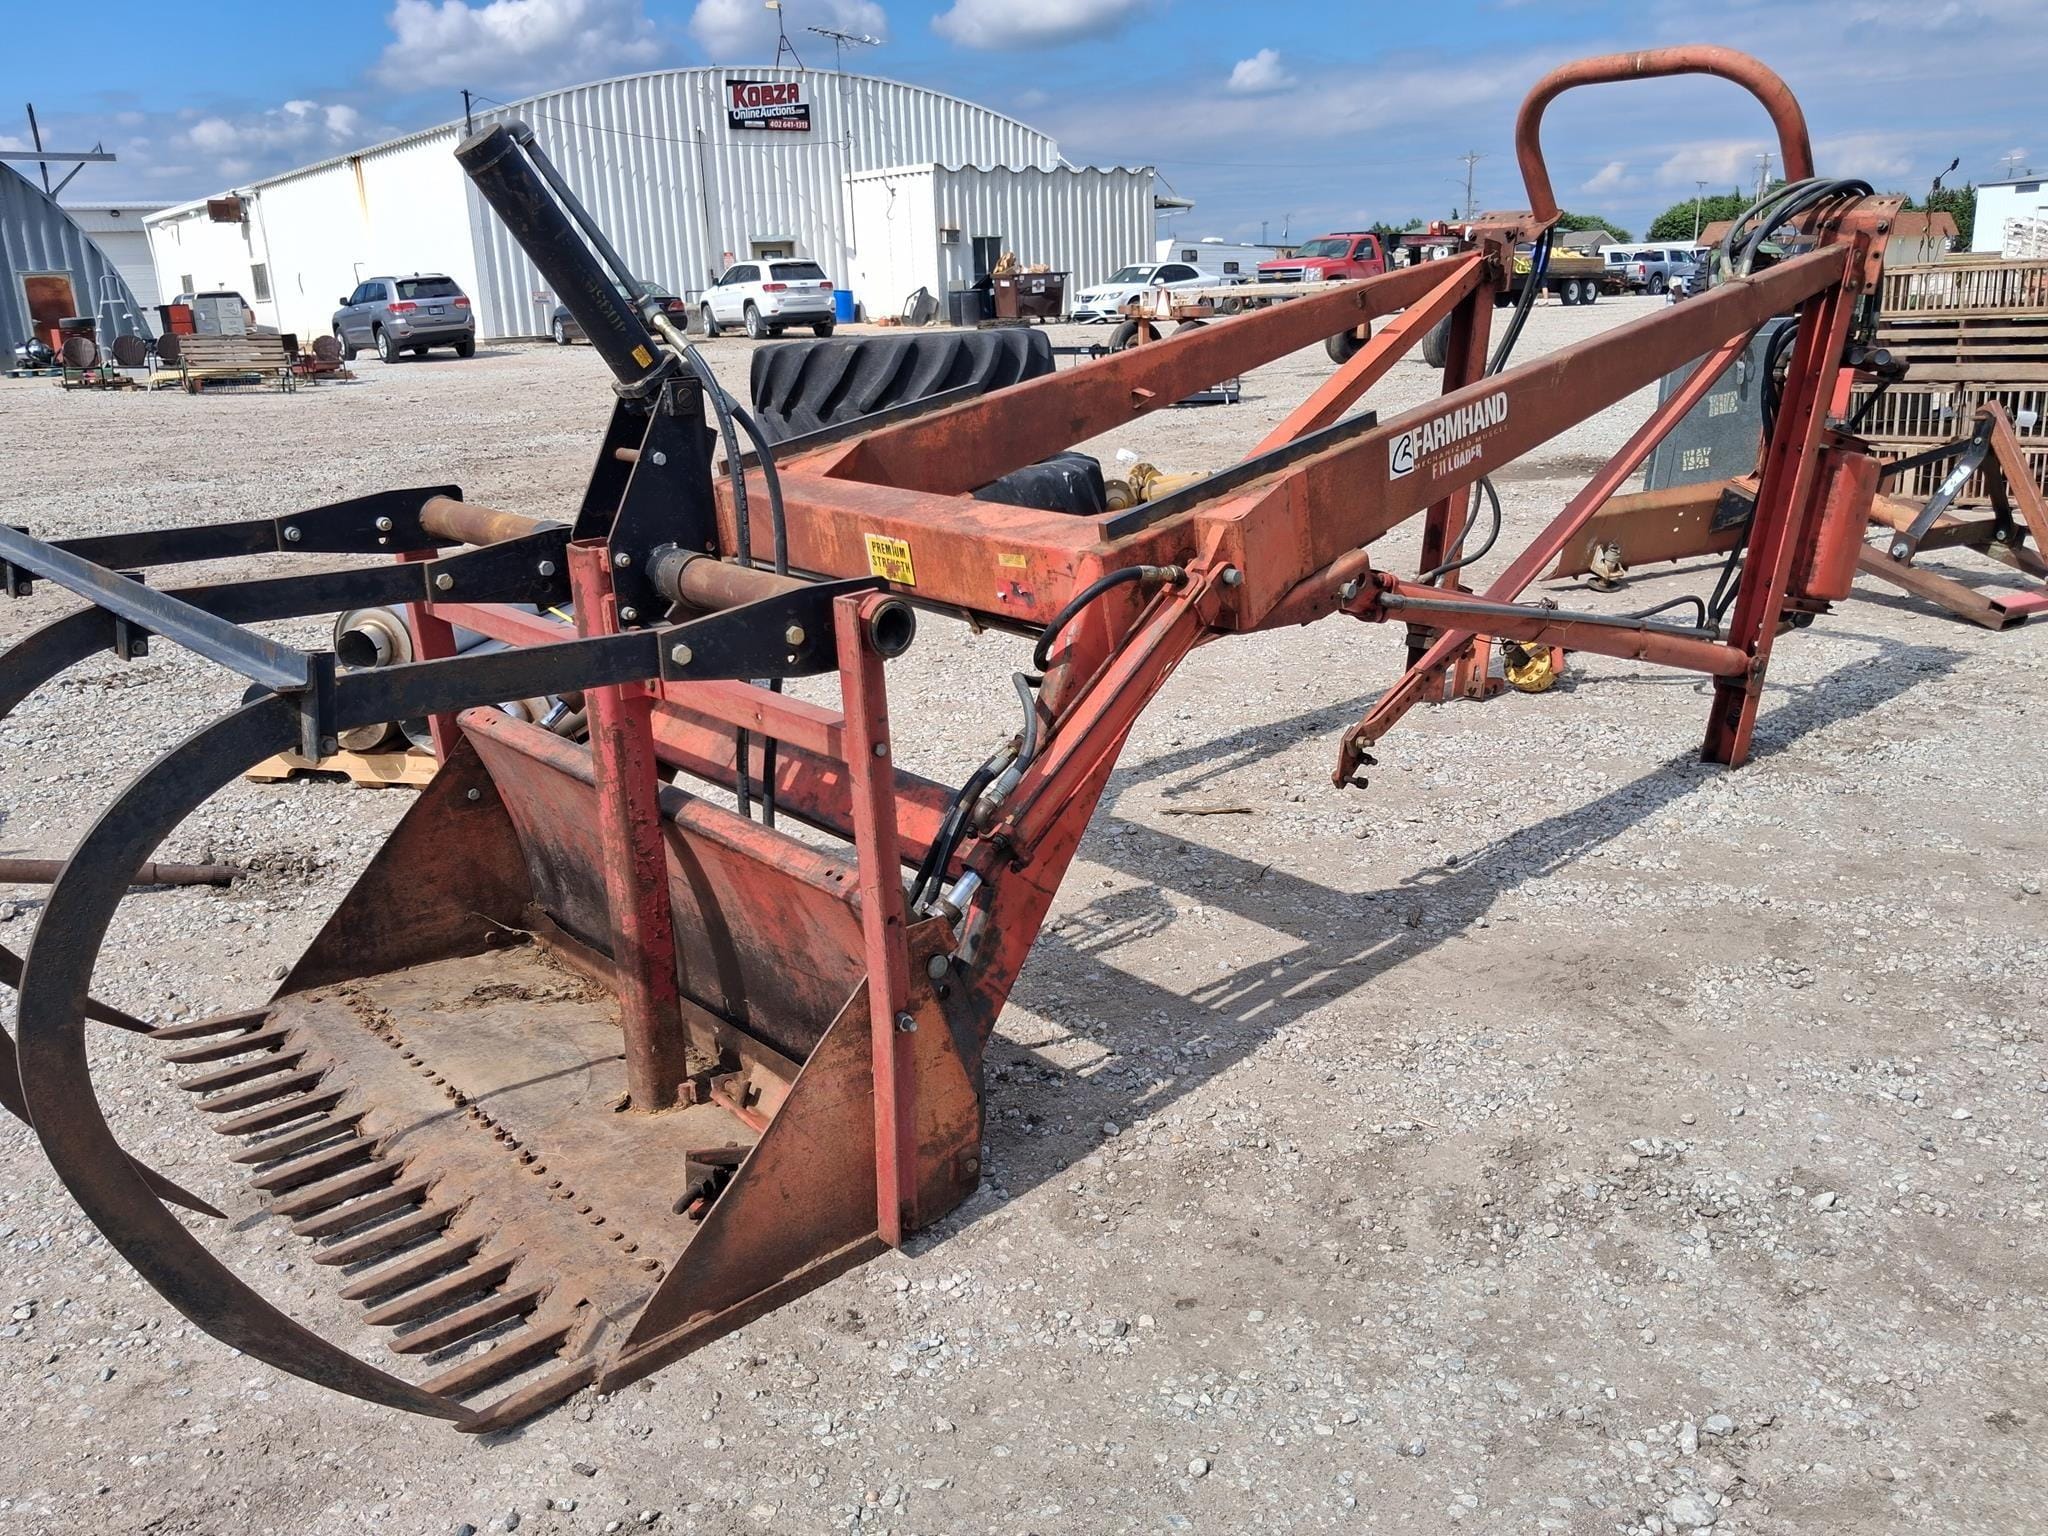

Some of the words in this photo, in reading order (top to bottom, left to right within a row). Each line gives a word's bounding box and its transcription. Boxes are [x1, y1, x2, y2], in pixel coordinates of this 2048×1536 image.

[732, 83, 800, 109] KOBZA
[1413, 391, 1508, 460] FARMHAND
[1414, 440, 1472, 471] MECHANIZED
[1448, 444, 1482, 472] LOADER
[871, 541, 906, 559] PREMIUM
